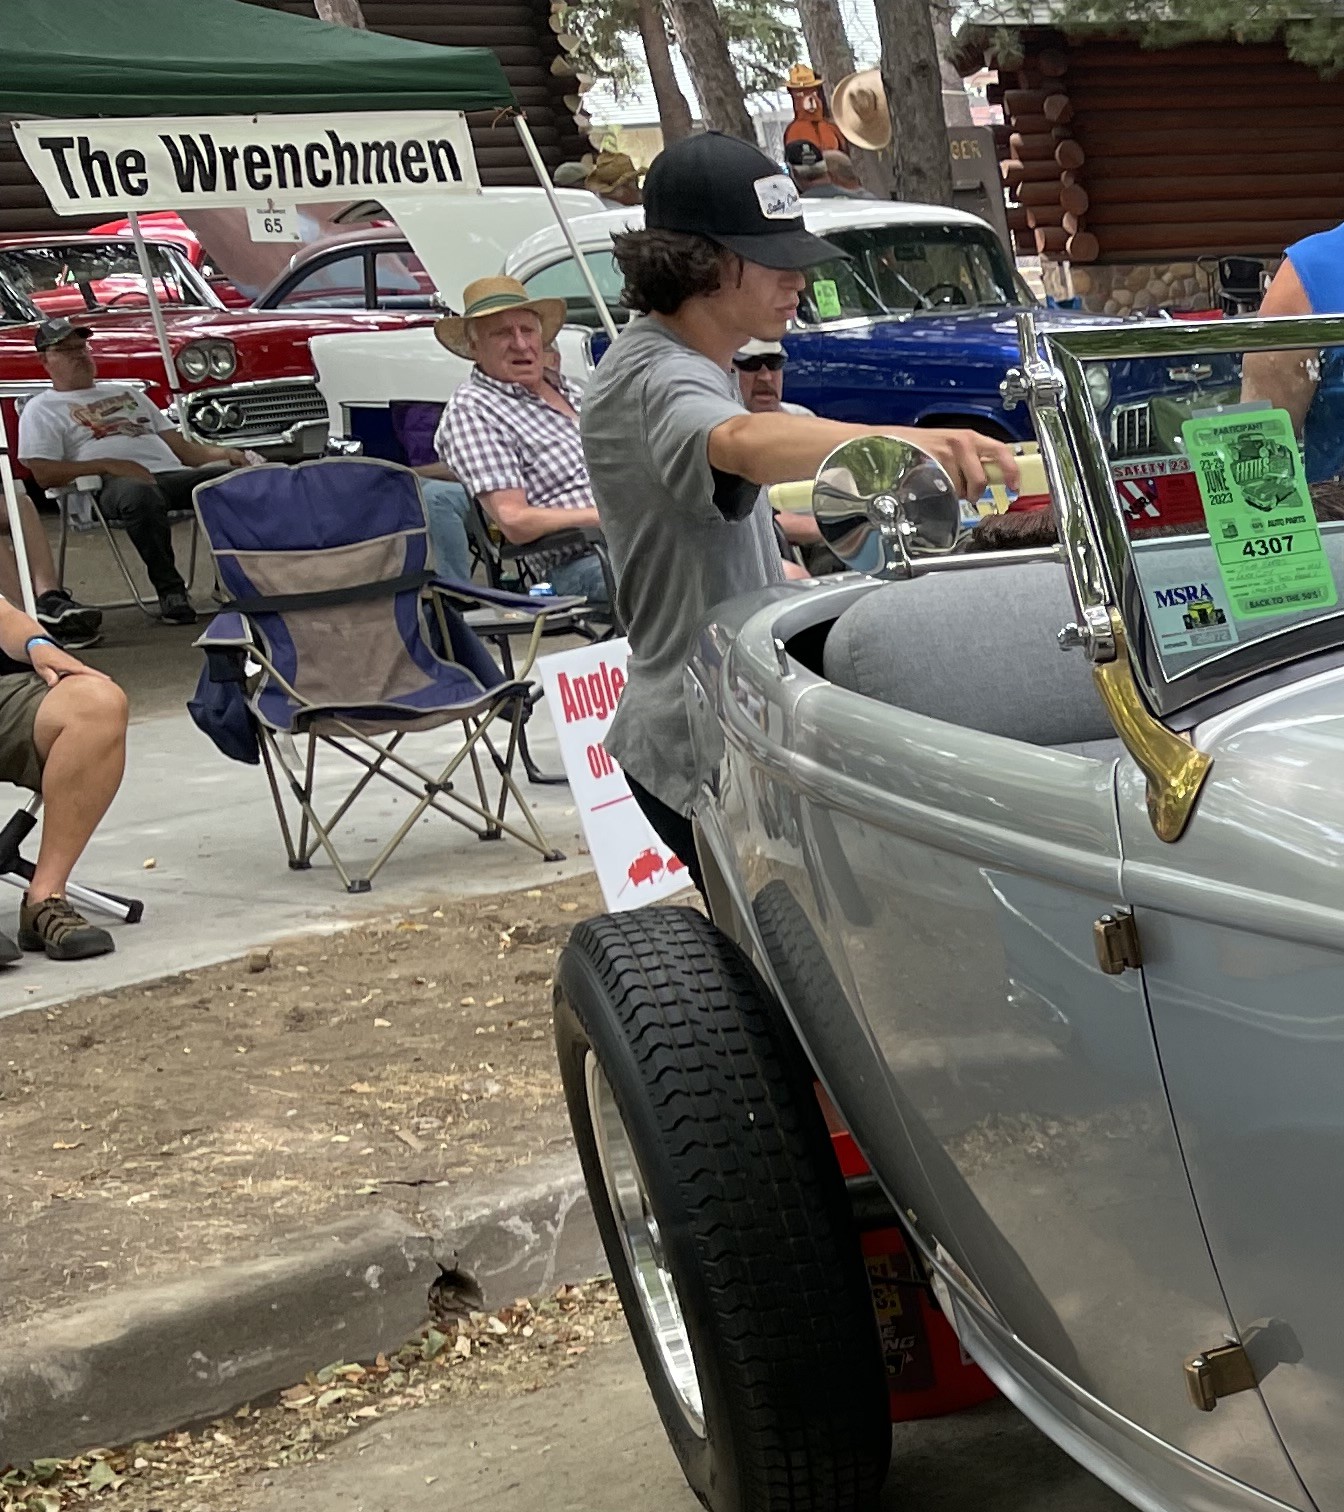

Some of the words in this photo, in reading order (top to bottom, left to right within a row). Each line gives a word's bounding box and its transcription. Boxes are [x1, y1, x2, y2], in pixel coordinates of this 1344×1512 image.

[38, 135, 148, 200] The
[159, 129, 464, 194] Wrenchmen
[264, 217, 293, 233] 65
[1213, 422, 1263, 435] PARTICIPANT
[1113, 462, 1166, 477] SAFETY
[1204, 469, 1230, 493] JUNE
[1209, 492, 1233, 505] 2023
[1285, 515, 1306, 526] PARTS
[1242, 535, 1294, 557] 4307
[1153, 583, 1213, 608] MSRA
[1249, 597, 1270, 608] BACK
[1270, 595, 1284, 605] TO
[1285, 592, 1300, 602] THE
